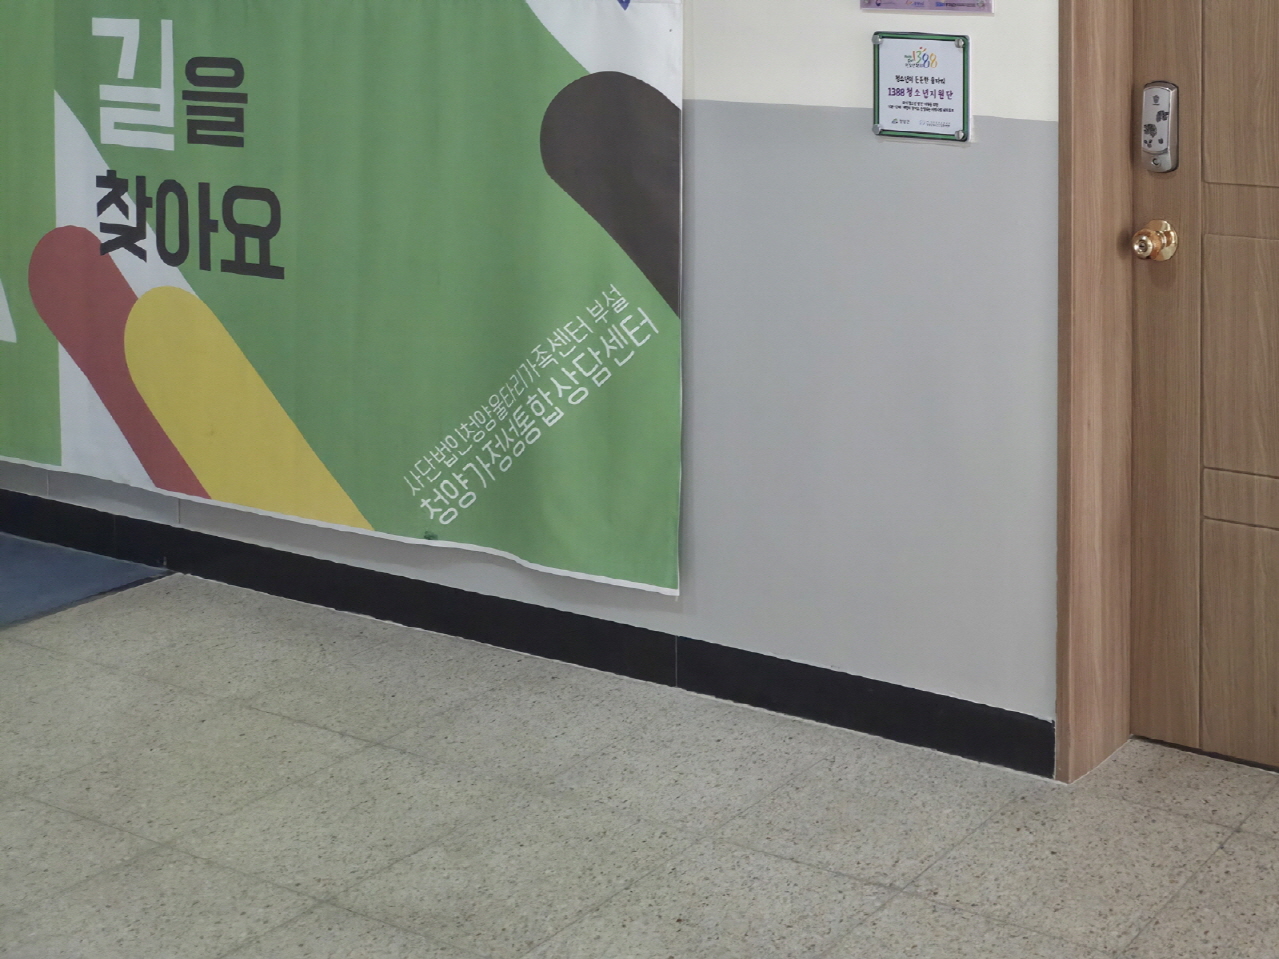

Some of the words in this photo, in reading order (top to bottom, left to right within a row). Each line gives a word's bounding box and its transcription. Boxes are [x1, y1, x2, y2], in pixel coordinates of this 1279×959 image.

[91, 16, 248, 151] 길을
[96, 170, 285, 279] 찾아요
[585, 283, 630, 324] 부설
[420, 307, 659, 525] 청양가정성통합상담센터
